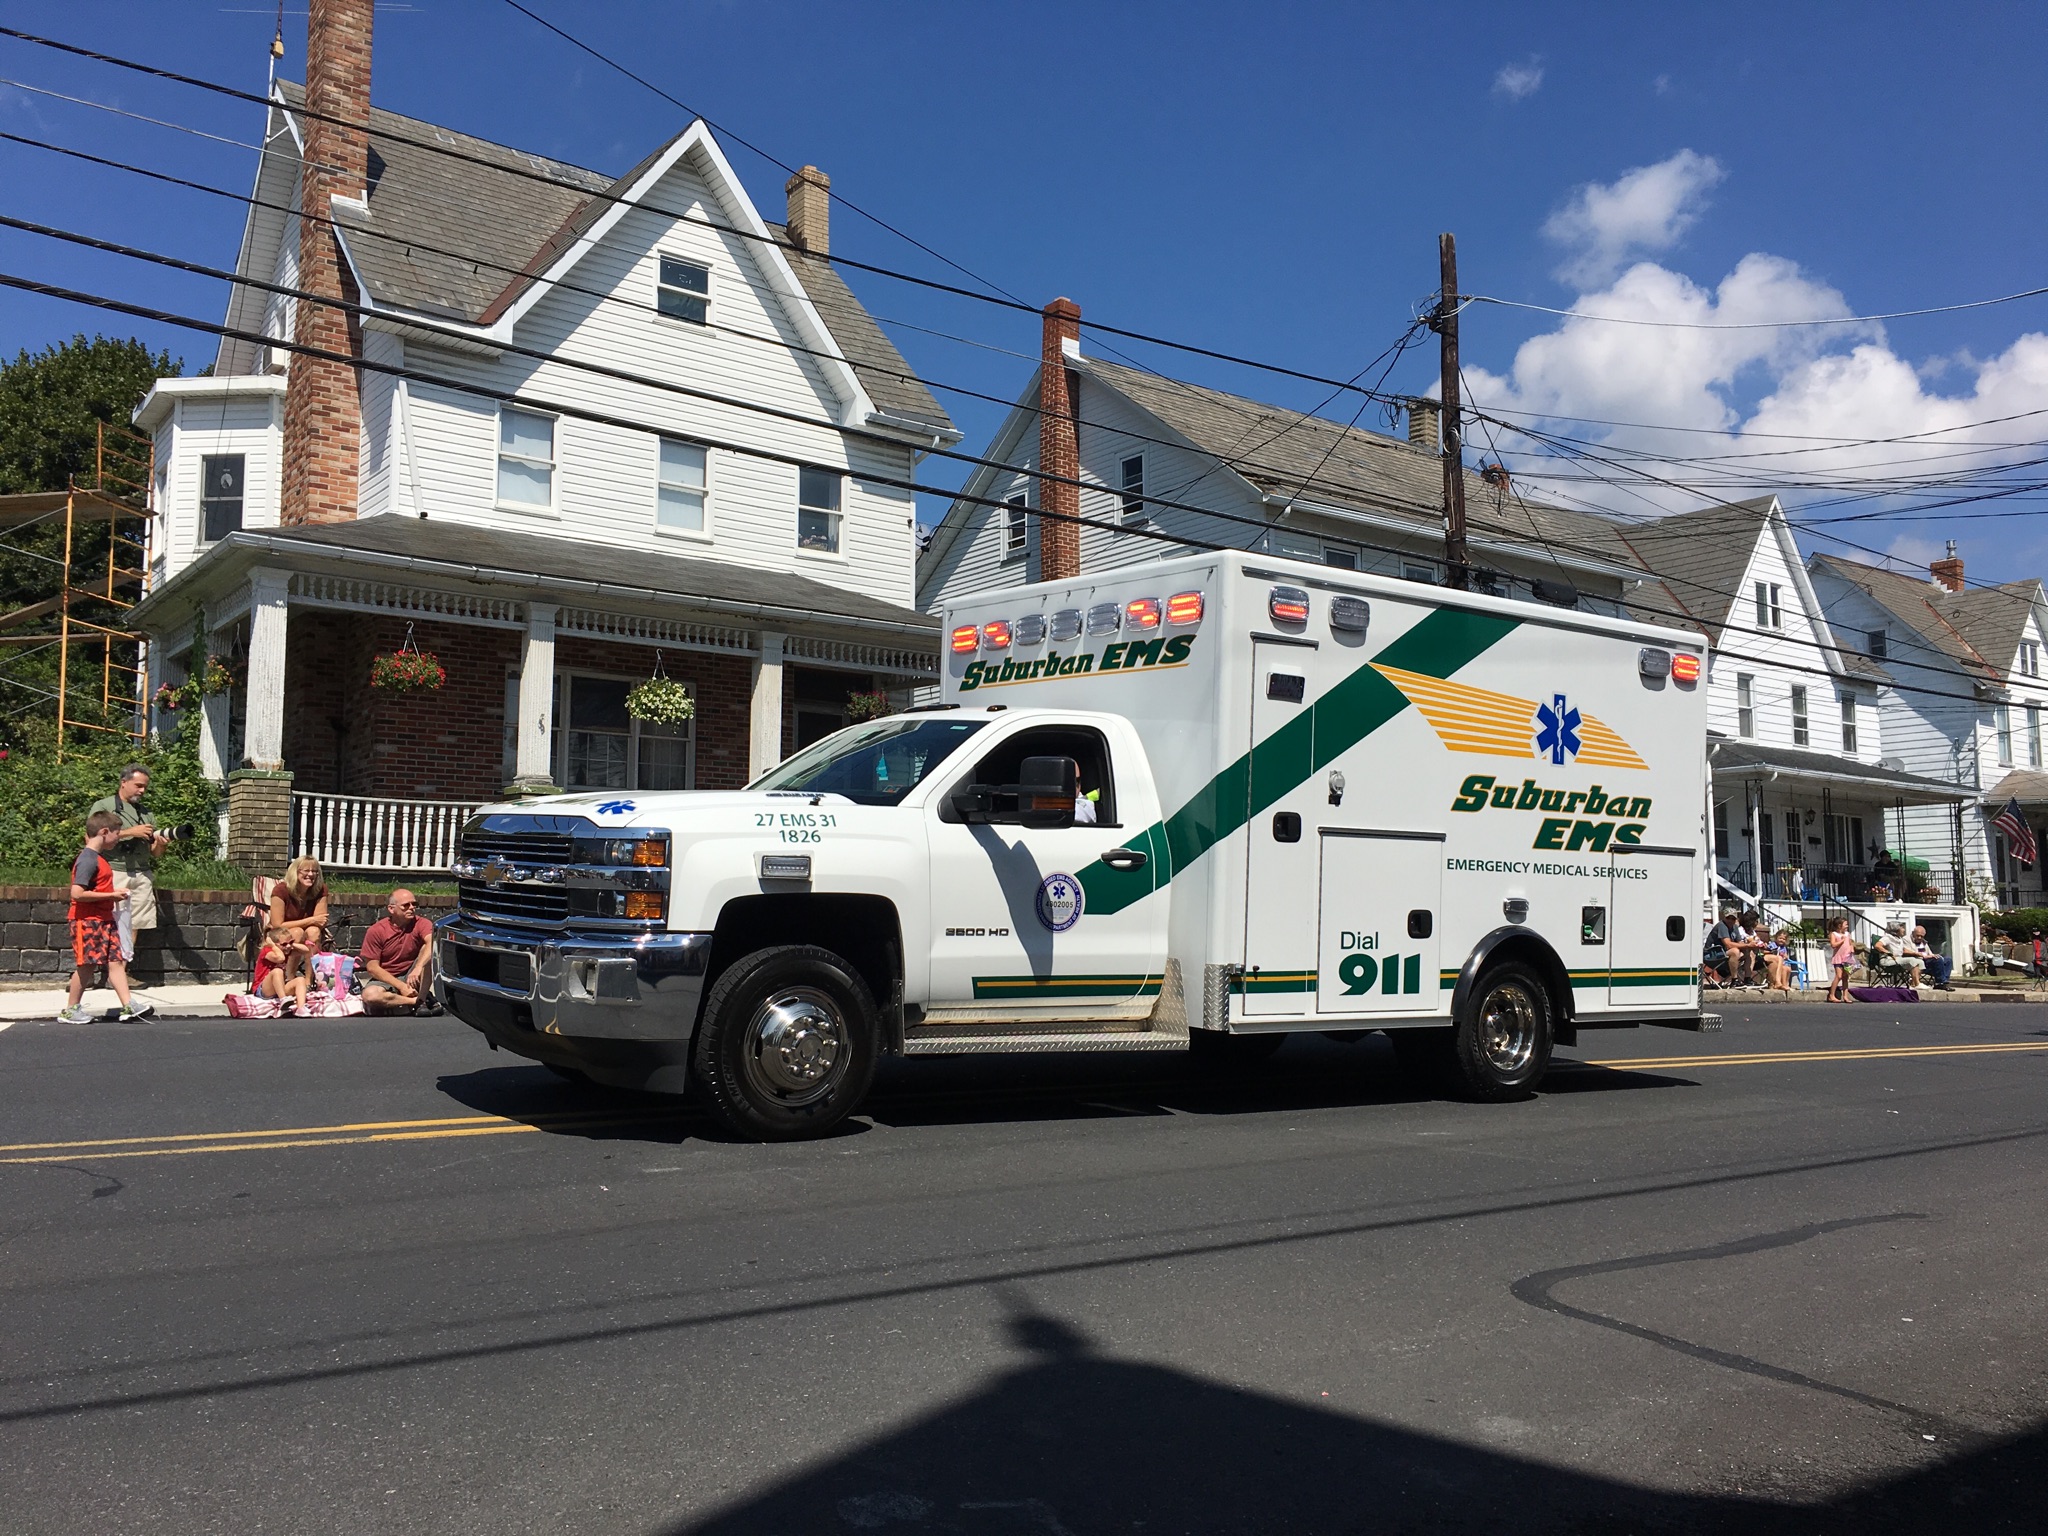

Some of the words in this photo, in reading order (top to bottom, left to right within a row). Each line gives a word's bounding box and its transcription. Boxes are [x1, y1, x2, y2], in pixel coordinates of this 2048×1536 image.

[958, 651, 1094, 692] Suburban
[1098, 634, 1197, 671] EMS
[1450, 774, 1653, 818] Suburban
[754, 813, 774, 826] 27
[780, 813, 816, 827] EMS
[819, 814, 837, 828] 31
[779, 829, 821, 843] 1826
[1532, 817, 1647, 855] EMS
[1446, 858, 1530, 874] EMERGENCY
[1533, 863, 1589, 877] MEDICAL
[1593, 866, 1648, 880] SERVICES
[988, 927, 1010, 937] HD
[1340, 931, 1379, 950] Dial
[1338, 953, 1421, 996] 911
